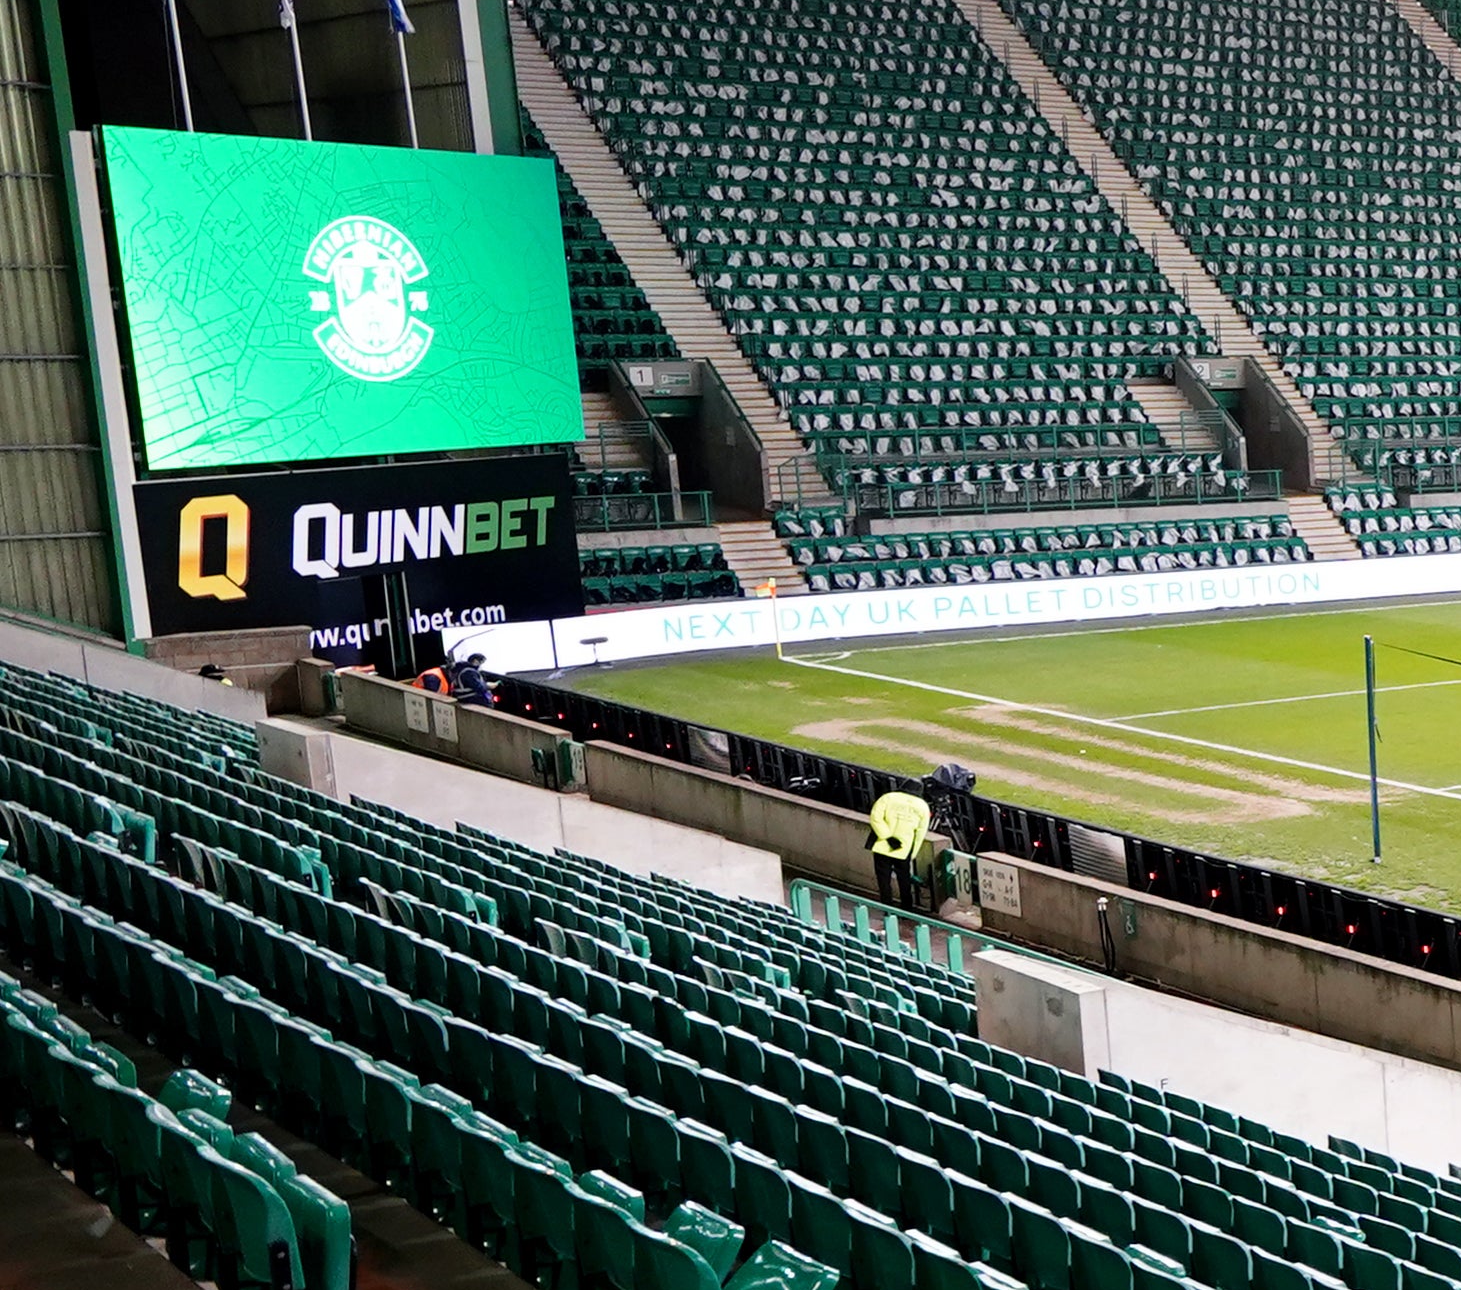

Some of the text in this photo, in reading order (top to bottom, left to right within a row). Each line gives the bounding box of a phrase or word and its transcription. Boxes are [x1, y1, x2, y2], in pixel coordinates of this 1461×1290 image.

[178, 494, 250, 601] Q
[664, 572, 1321, 642] NEXT DAY UK PALLET DISTRIBUTION
[955, 866, 972, 895] 18
